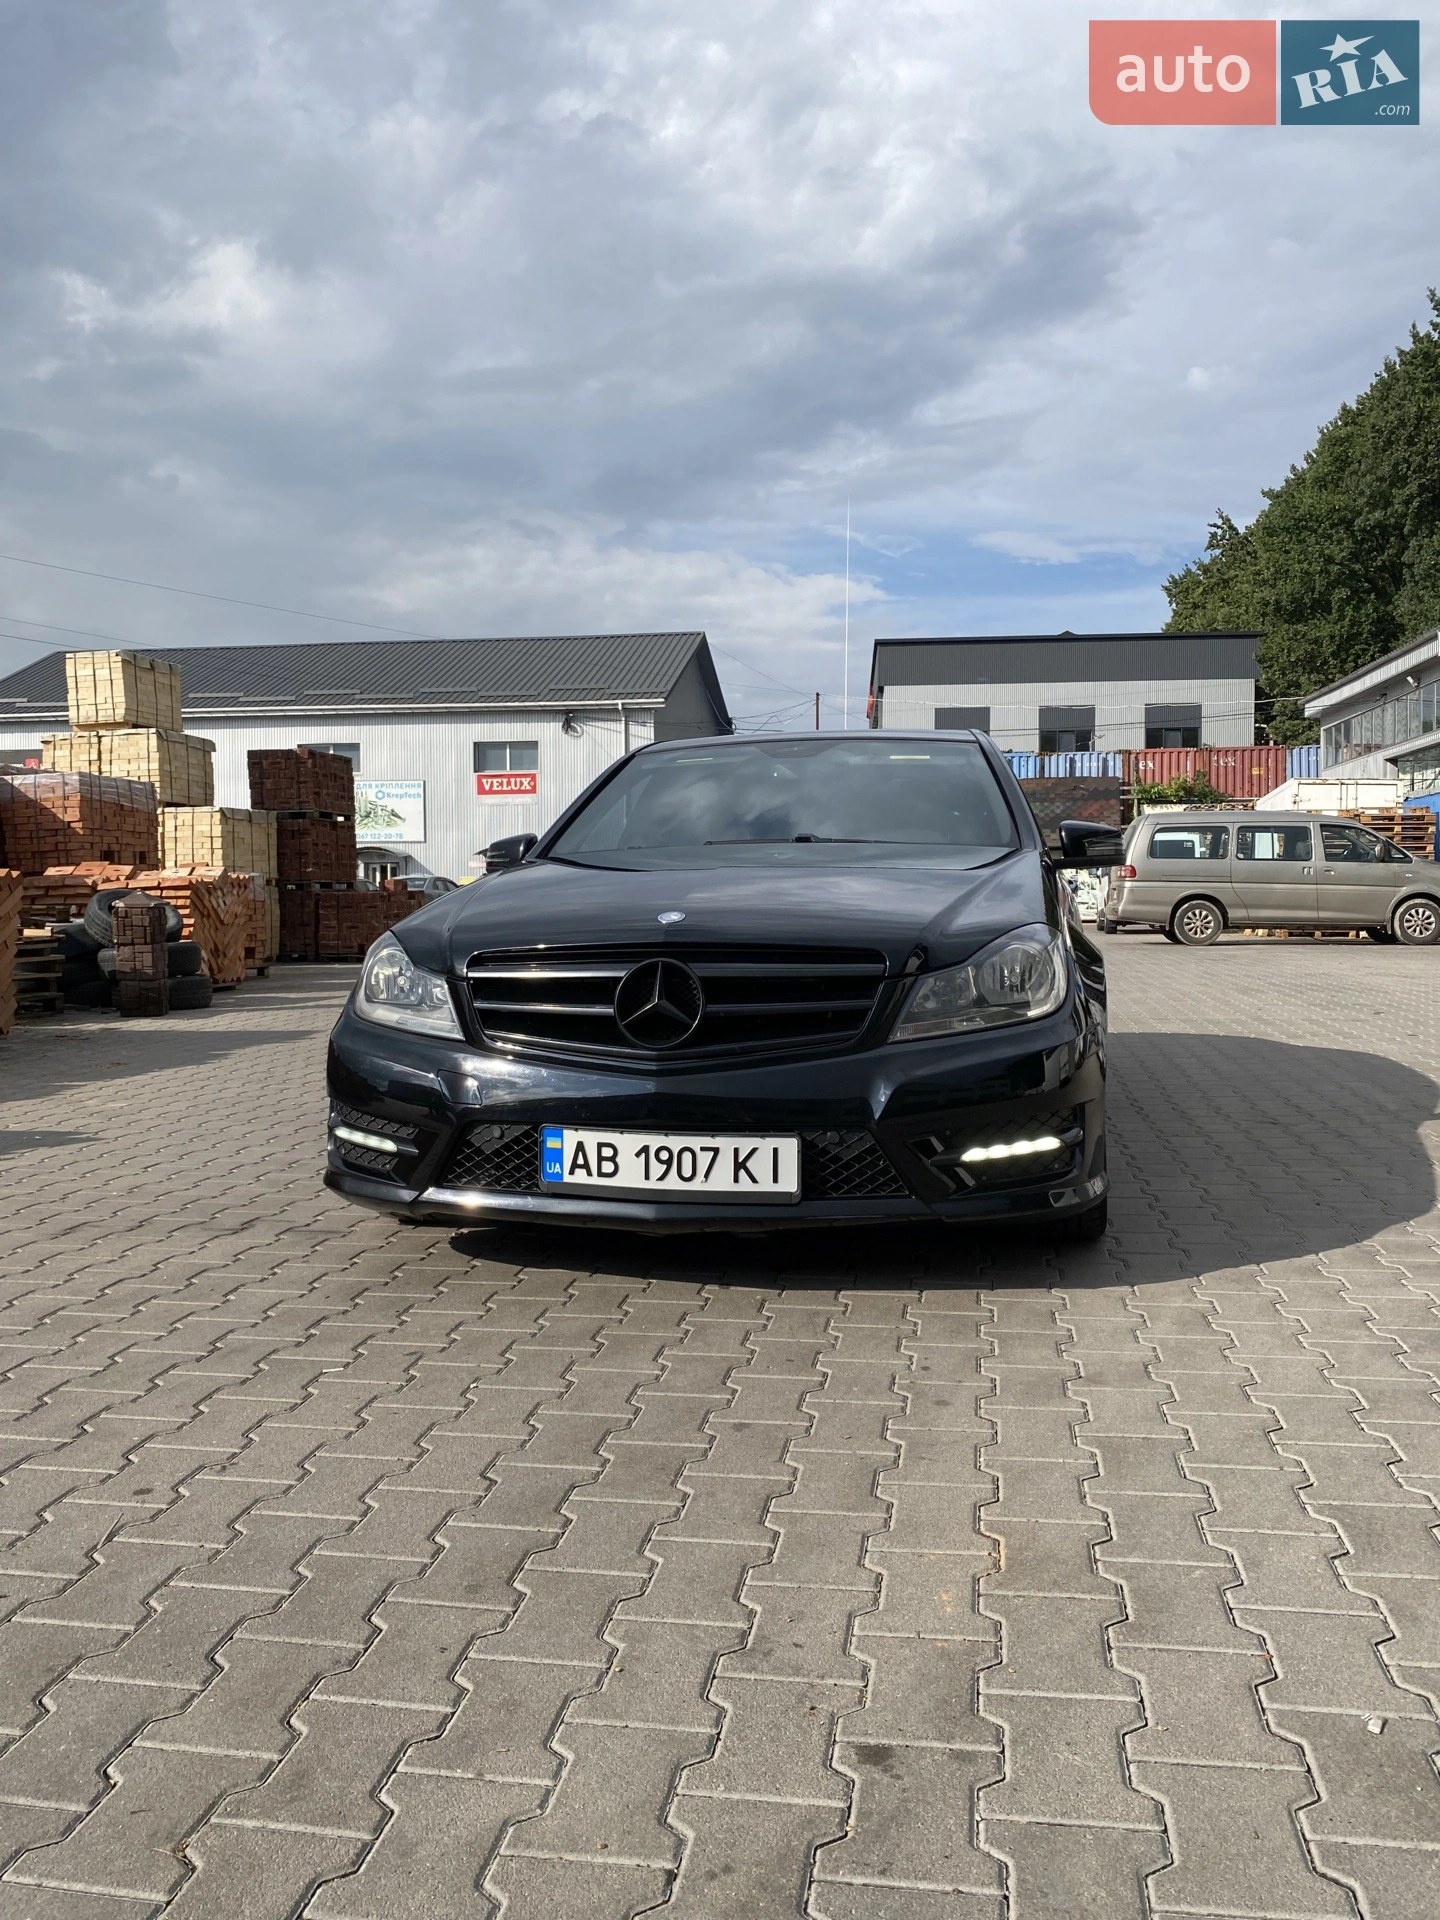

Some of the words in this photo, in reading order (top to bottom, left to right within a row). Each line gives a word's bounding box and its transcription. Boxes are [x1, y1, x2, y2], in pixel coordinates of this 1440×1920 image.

[375, 782, 422, 790] КРІПЛЕННЯ
[481, 777, 532, 791] VELUX
[386, 792, 422, 800] KrepTech
[568, 1140, 620, 1179] AB
[634, 1143, 720, 1183] 1907
[546, 1162, 562, 1174] UA
